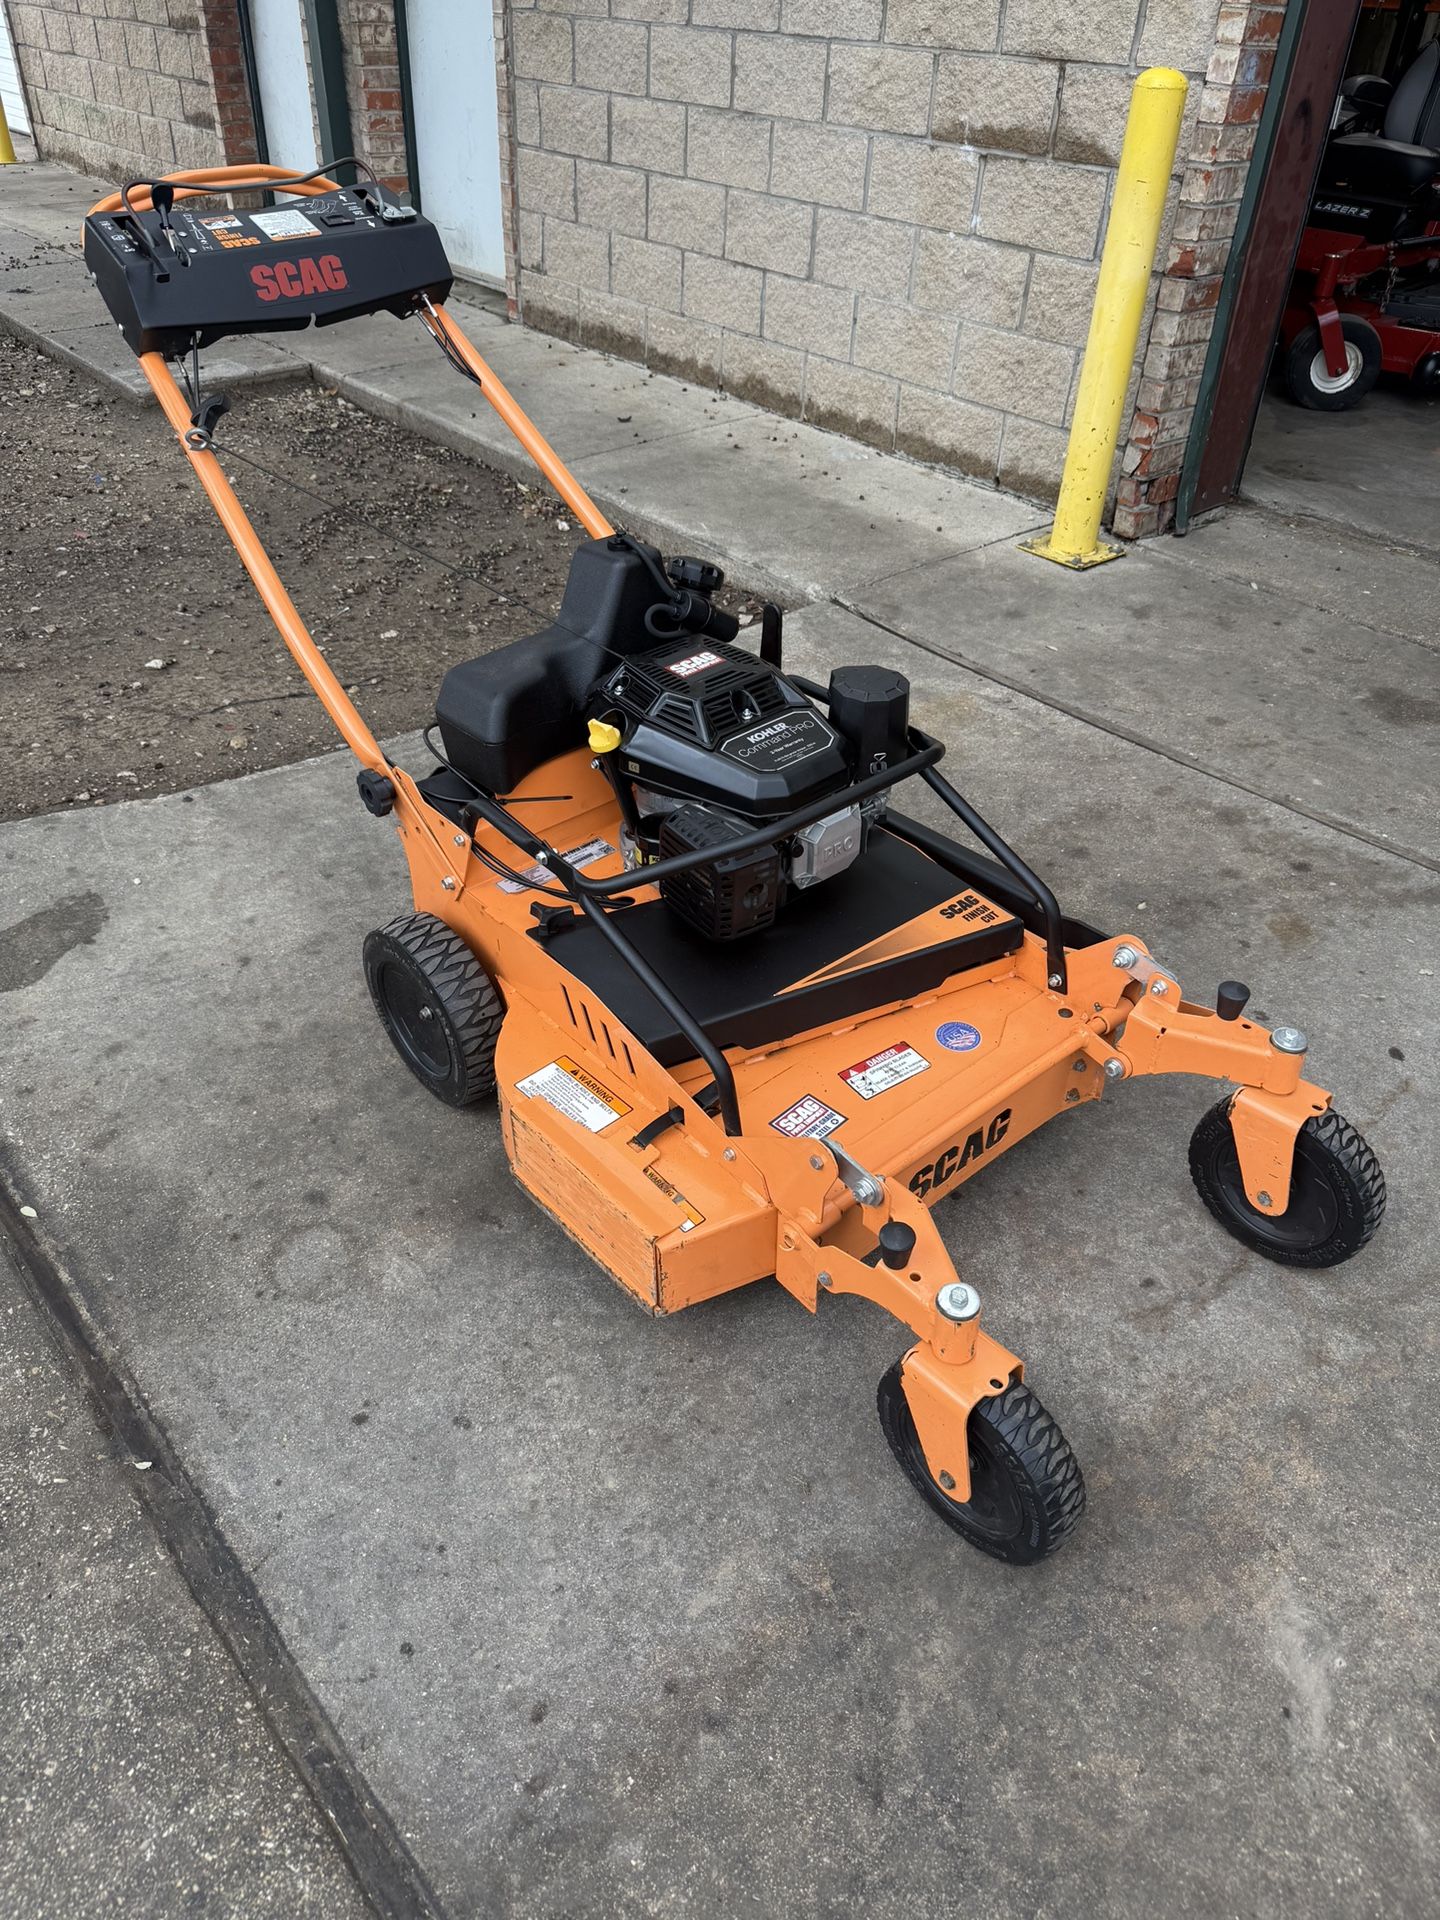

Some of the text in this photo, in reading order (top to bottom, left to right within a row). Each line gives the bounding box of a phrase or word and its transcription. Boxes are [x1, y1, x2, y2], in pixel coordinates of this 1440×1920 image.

[1315, 200, 1372, 218] LAZER Z
[220, 236, 262, 249] SCAG
[250, 254, 348, 301] SCAG
[669, 651, 717, 673] SCAG
[738, 729, 791, 757] Command
[789, 720, 815, 735] PRO
[746, 722, 790, 744] KOHLER
[824, 835, 854, 863] PRO
[939, 895, 980, 920] SCAG
[962, 904, 990, 922] FINISH
[980, 910, 999, 923] CUT
[945, 1028, 970, 1042] USA
[865, 1048, 898, 1067] DANGER
[579, 1074, 614, 1103] WARNING
[778, 1099, 821, 1131] SCAG
[908, 1107, 1013, 1199] SCAG
